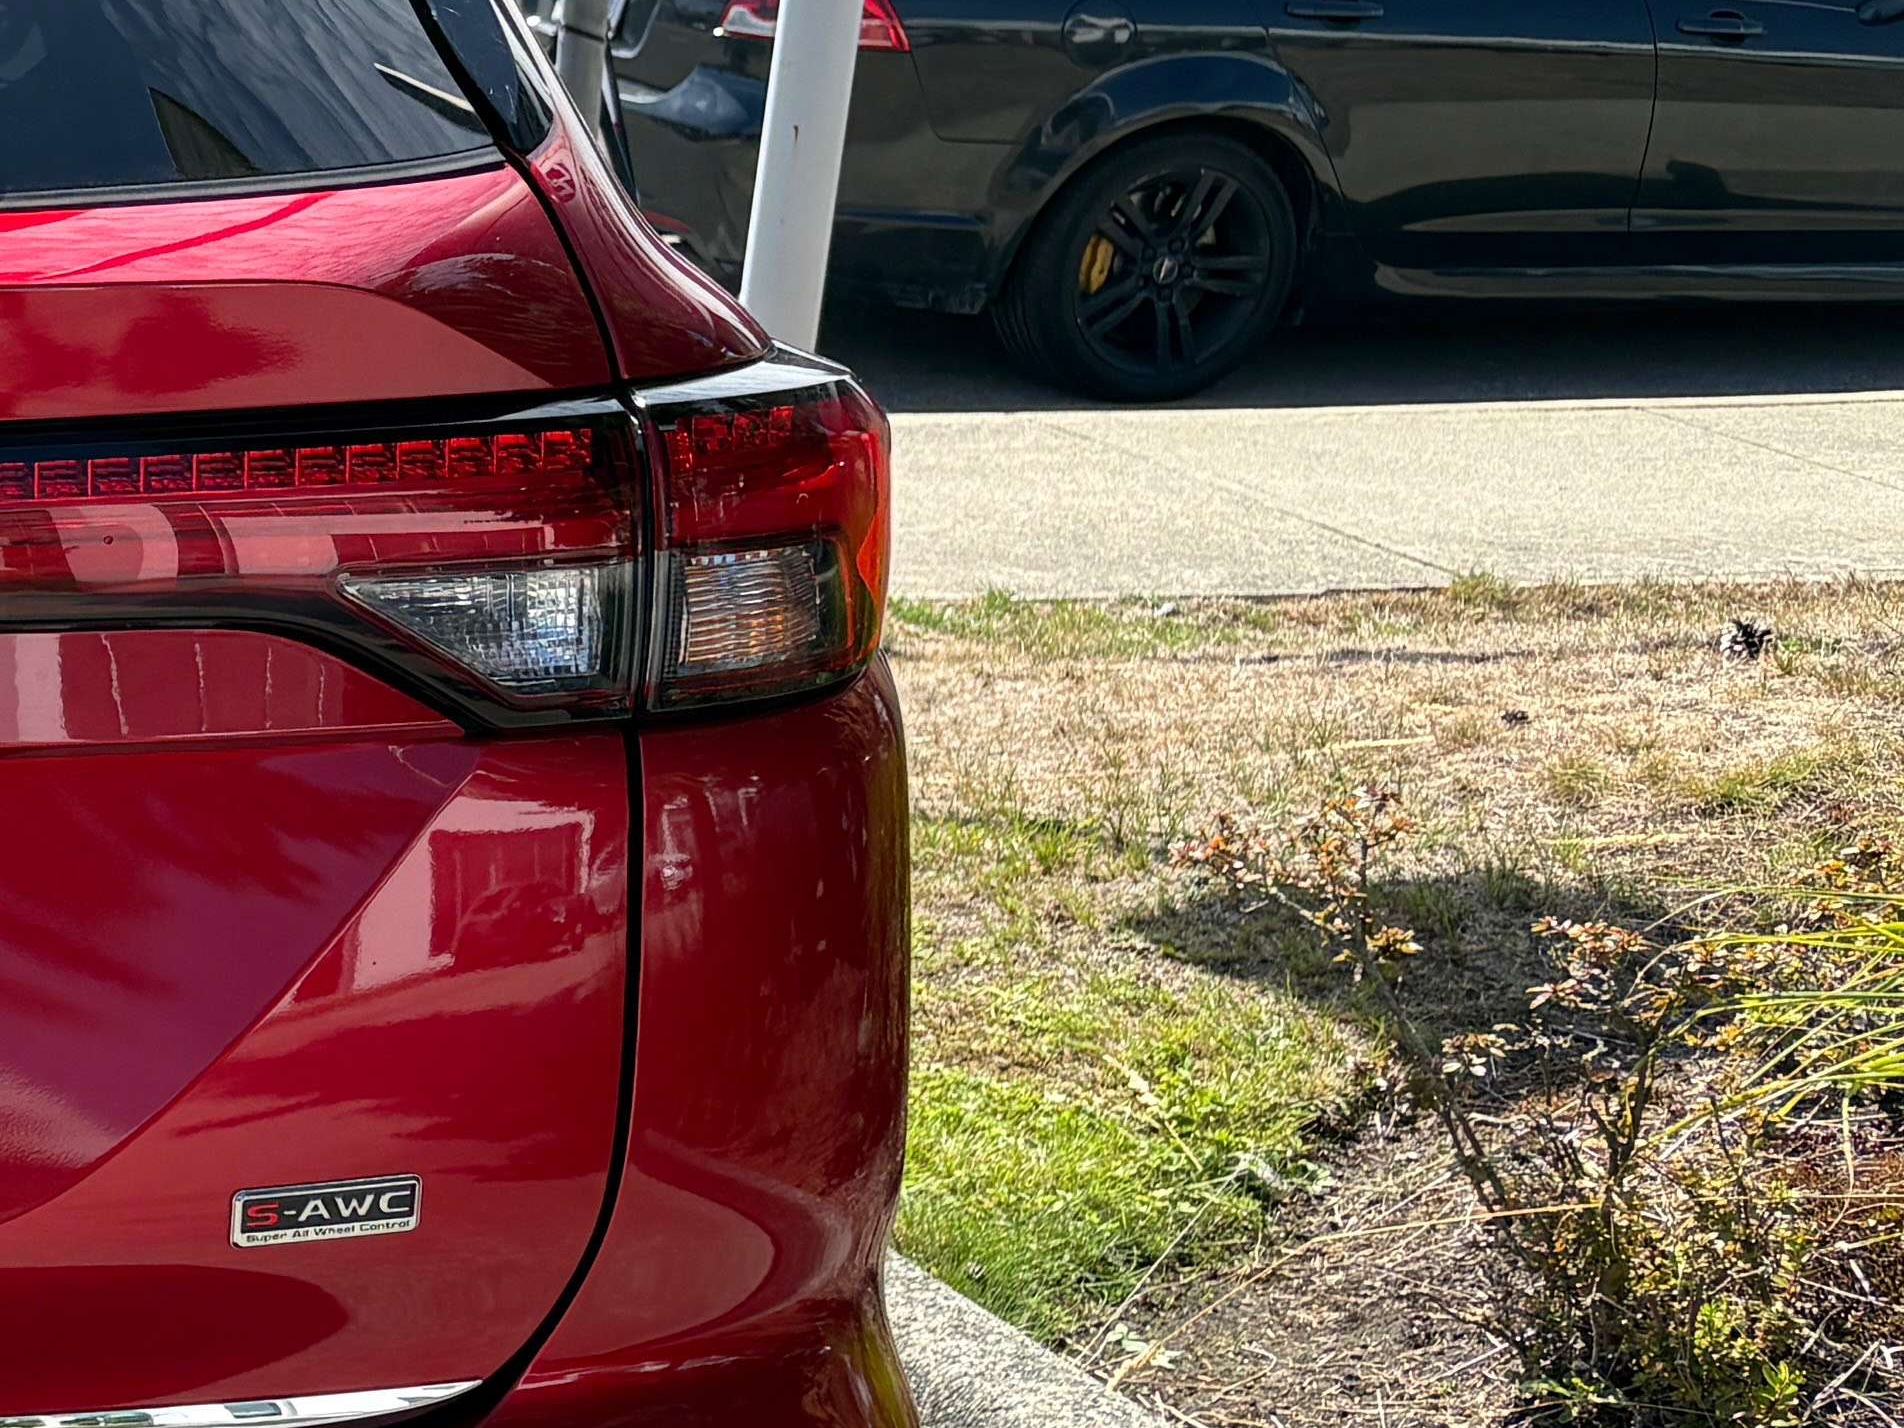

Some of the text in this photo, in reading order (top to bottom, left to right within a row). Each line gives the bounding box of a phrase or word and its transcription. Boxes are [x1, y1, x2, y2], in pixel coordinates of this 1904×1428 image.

[246, 1189, 411, 1227] S-AWC
[246, 1219, 411, 1243] Super All Wheel Control
